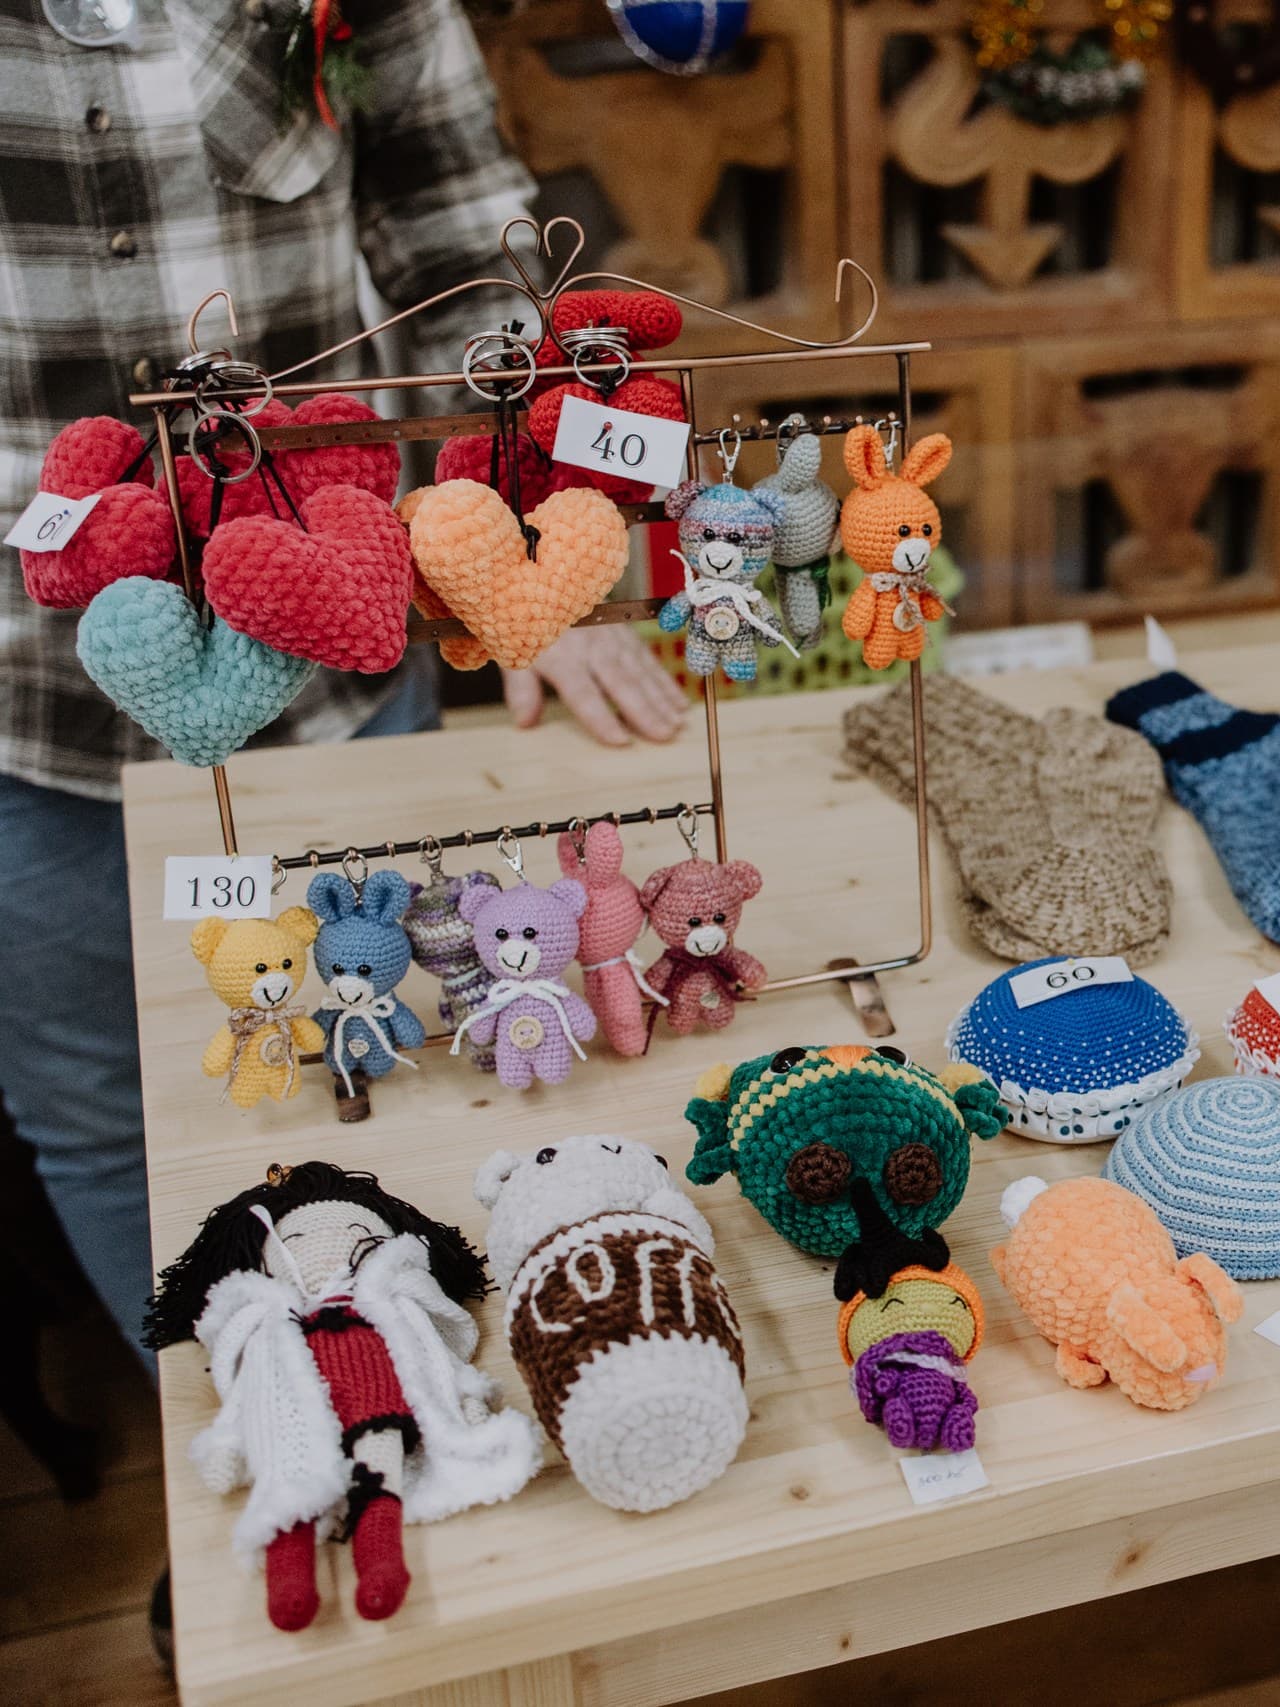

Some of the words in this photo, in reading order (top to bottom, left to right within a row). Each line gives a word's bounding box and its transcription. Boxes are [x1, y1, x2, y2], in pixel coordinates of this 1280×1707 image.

[591, 423, 647, 467] 40
[187, 876, 256, 907] 130
[1046, 966, 1095, 988] 60
